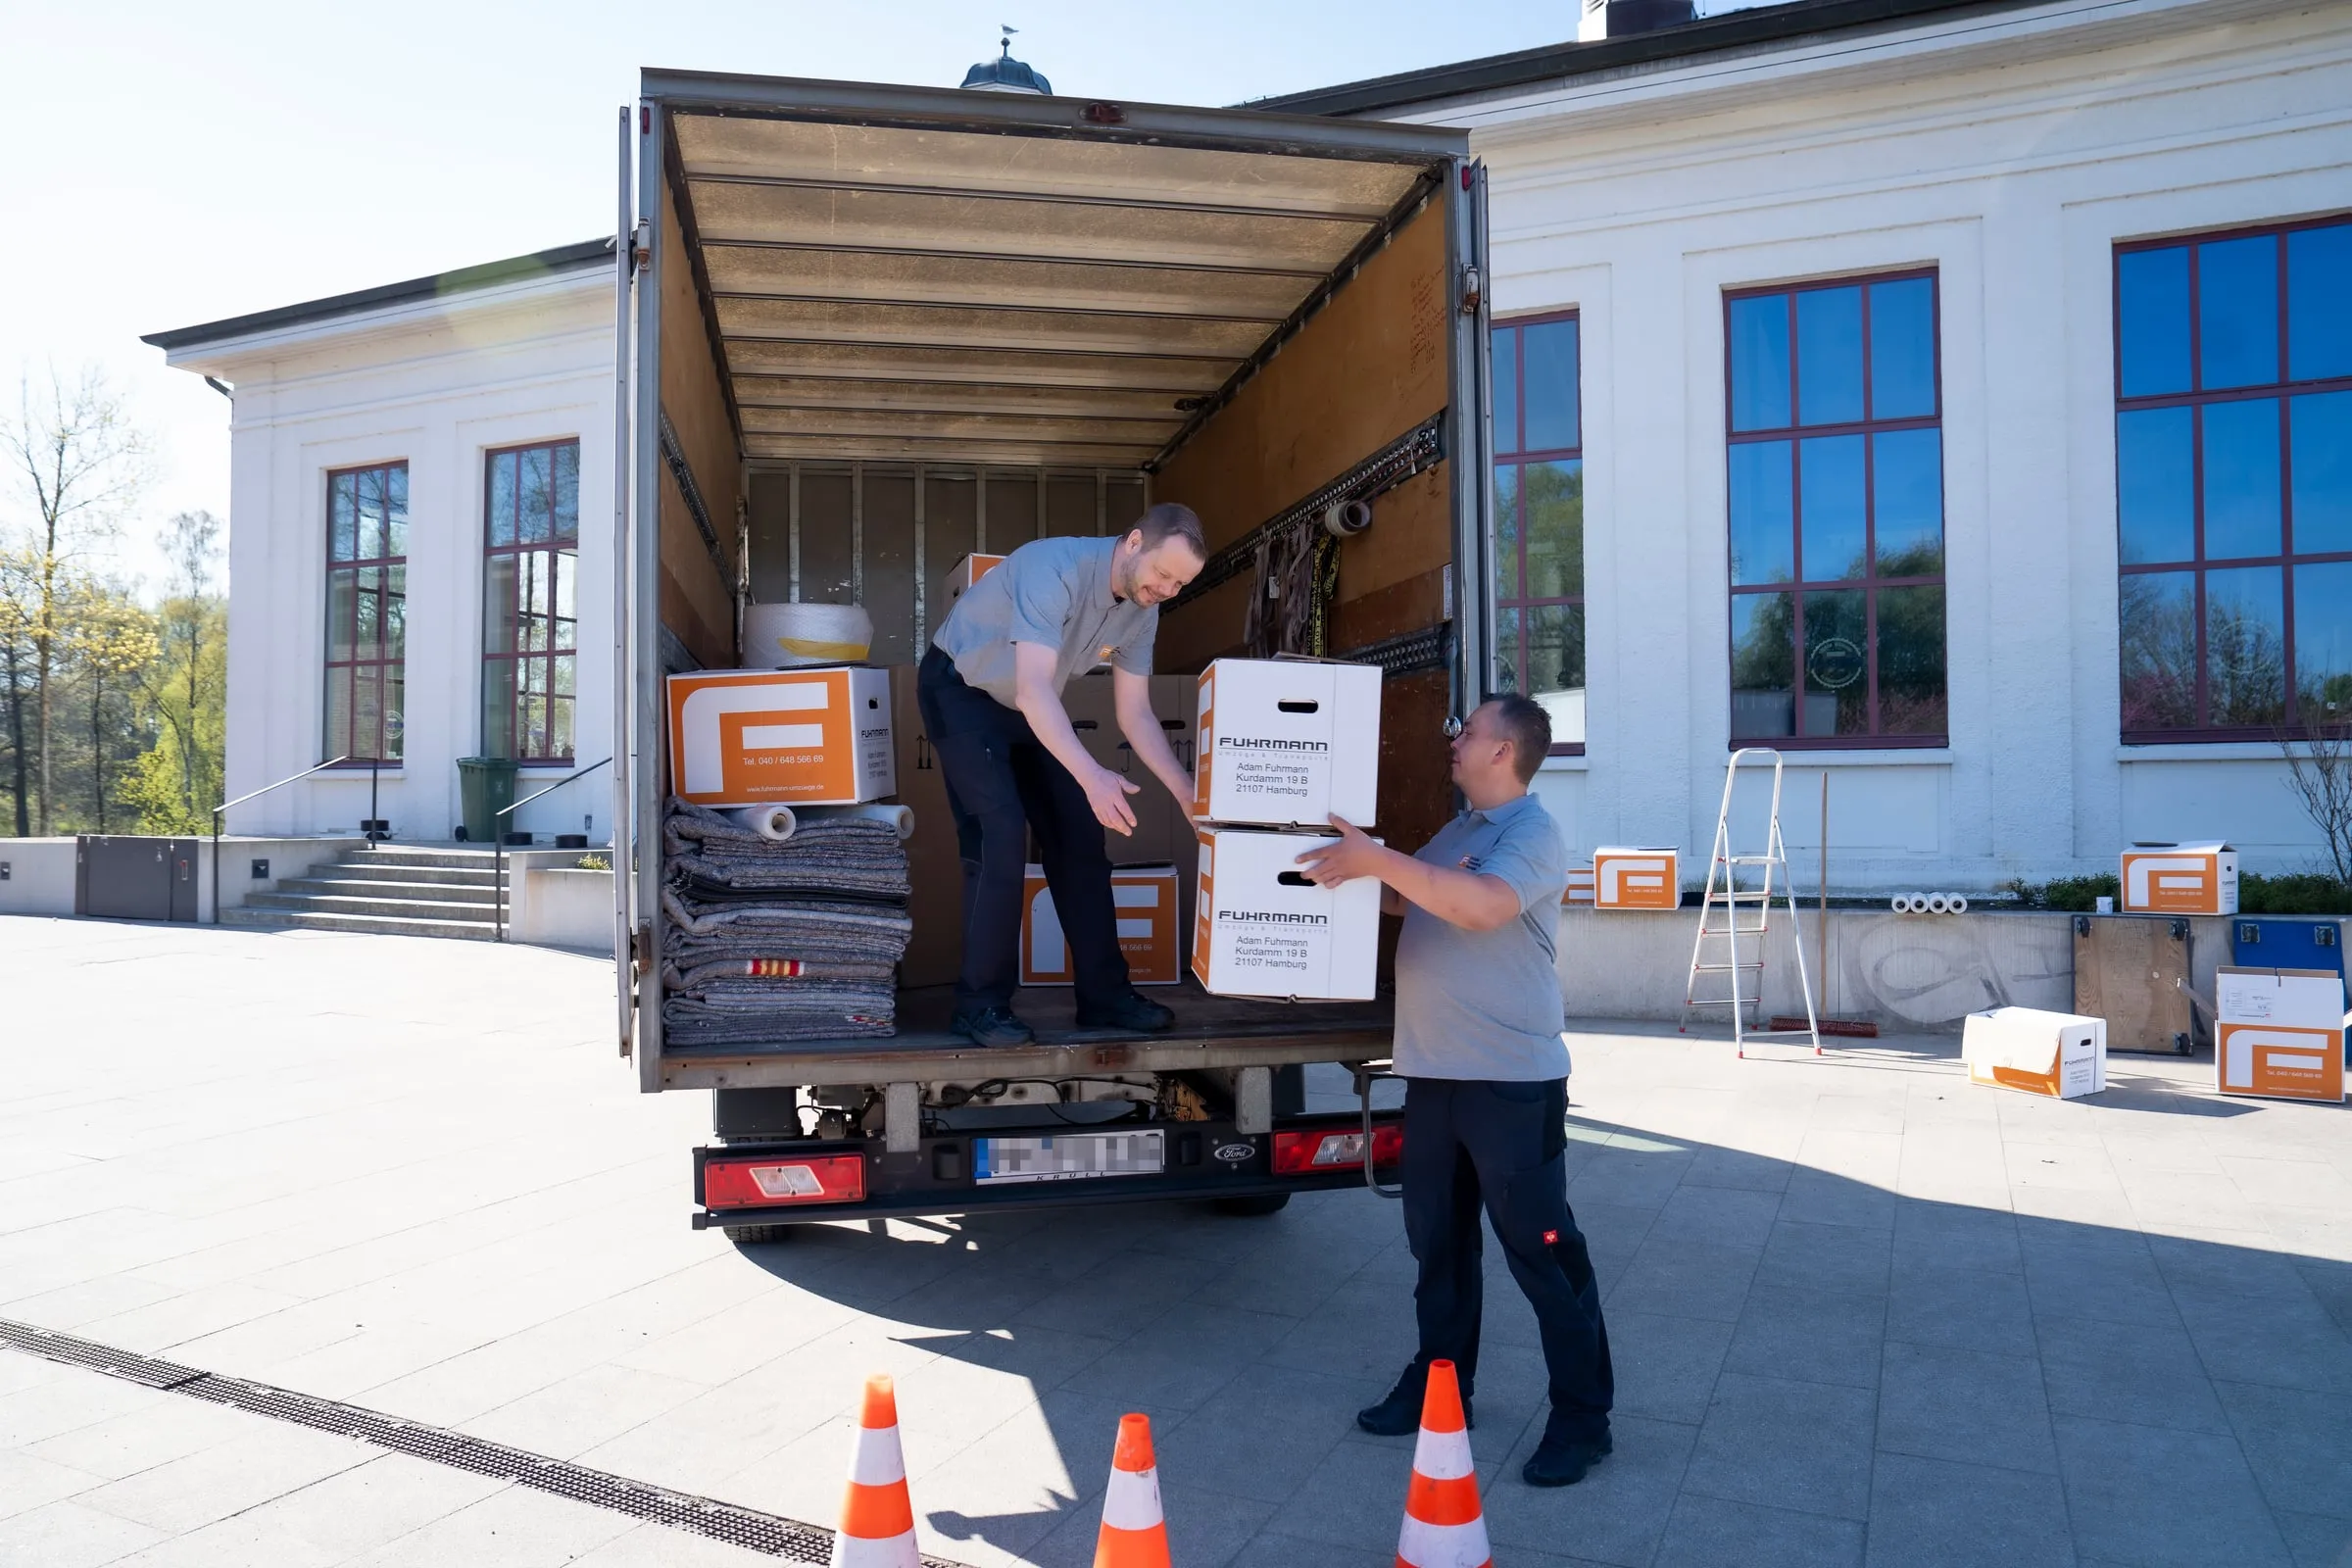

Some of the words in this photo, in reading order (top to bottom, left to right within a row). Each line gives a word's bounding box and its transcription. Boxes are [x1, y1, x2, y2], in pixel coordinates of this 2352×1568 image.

[1219, 737, 1328, 752] FUHRMANN
[779, 756, 795, 764] 648
[1237, 762, 1263, 772] Adam
[1265, 763, 1309, 773] Fuhrmann
[1236, 773, 1283, 783] Kurdamm
[747, 784, 824, 793] www.fuhrmann-umzuege.de
[1236, 784, 1263, 793] 21107
[1266, 786, 1308, 797] Hamburg
[1218, 910, 1328, 924] FUHRMANN
[1236, 936, 1262, 945] Adam
[1264, 937, 1308, 947] Fuhrmann
[1235, 947, 1283, 956] Kurdamm
[1299, 949, 1307, 957] B
[1235, 957, 1262, 966] 21107
[1265, 959, 1307, 970] Hamburg
[1224, 1147, 1247, 1157] Ford
